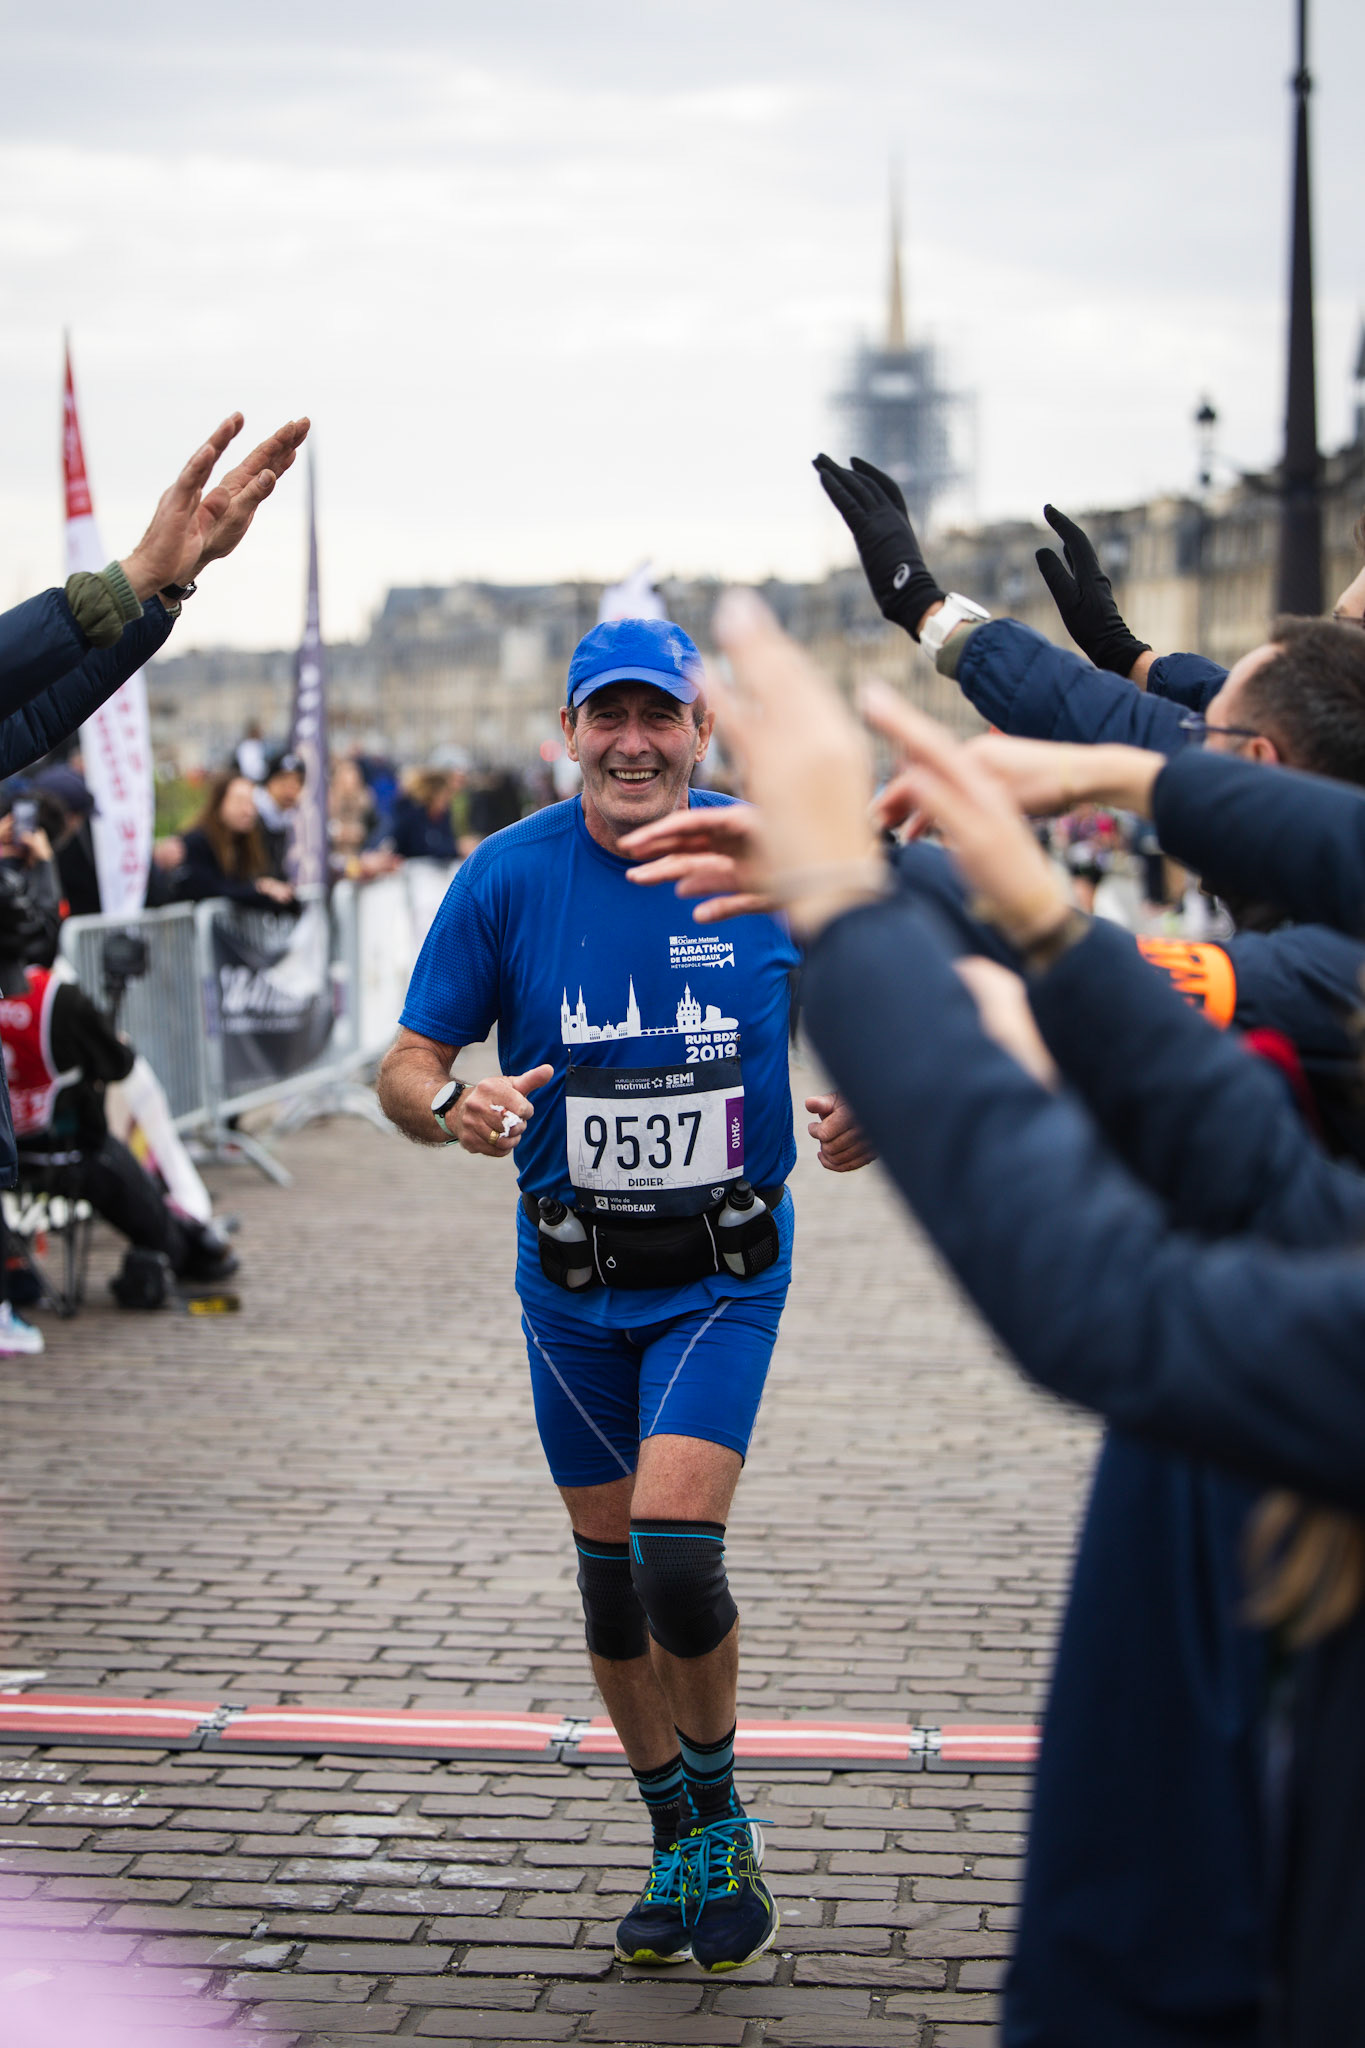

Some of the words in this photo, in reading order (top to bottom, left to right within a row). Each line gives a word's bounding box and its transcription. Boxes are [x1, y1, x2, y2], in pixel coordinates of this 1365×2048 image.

[698, 935, 719, 943] Matmut
[669, 942, 734, 957] MARATHON
[670, 956, 681, 964] DE
[681, 953, 721, 963] BORDEAUX
[685, 1034, 713, 1045] RUN
[713, 1032, 737, 1044] BDX
[685, 1043, 737, 1064] 2019
[665, 1071, 694, 1085] SEMI
[614, 1081, 651, 1091] matmut
[731, 1116, 741, 1149] +2H10
[584, 1110, 702, 1170] 9537
[628, 1177, 664, 1187] DIDIER
[610, 1203, 657, 1213] BORDEAUX
